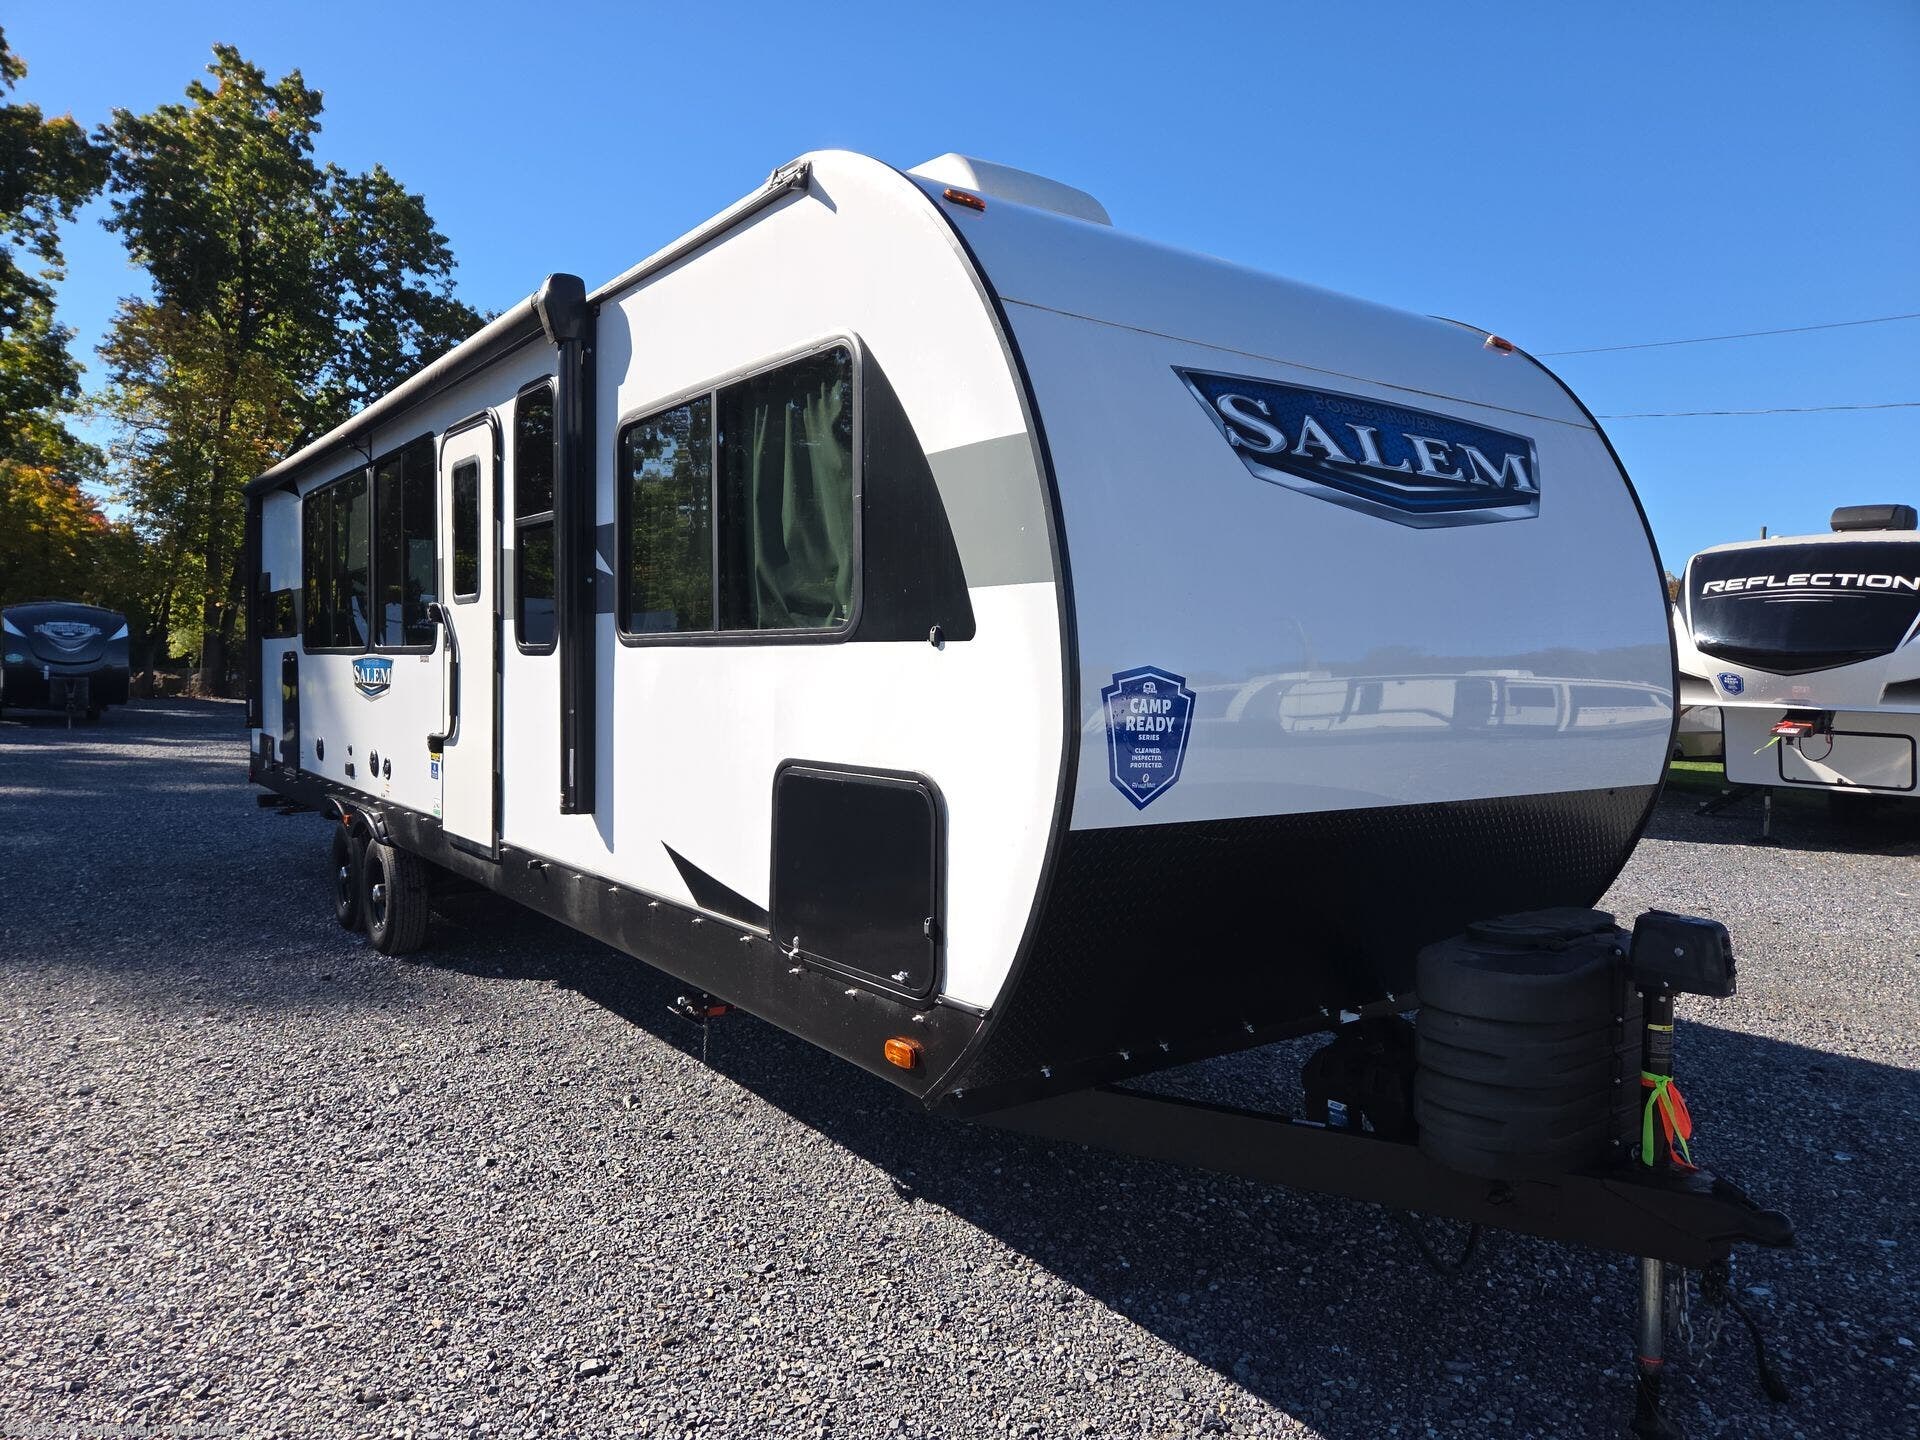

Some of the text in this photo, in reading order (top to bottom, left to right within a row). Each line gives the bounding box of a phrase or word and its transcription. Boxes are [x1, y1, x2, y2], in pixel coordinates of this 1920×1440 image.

[1216, 394, 1540, 494] SALEM
[1702, 573, 1920, 595] REFLECTION
[353, 664, 392, 685] SALEM
[1130, 698, 1172, 714] CAMP
[1125, 715, 1175, 733] READY
